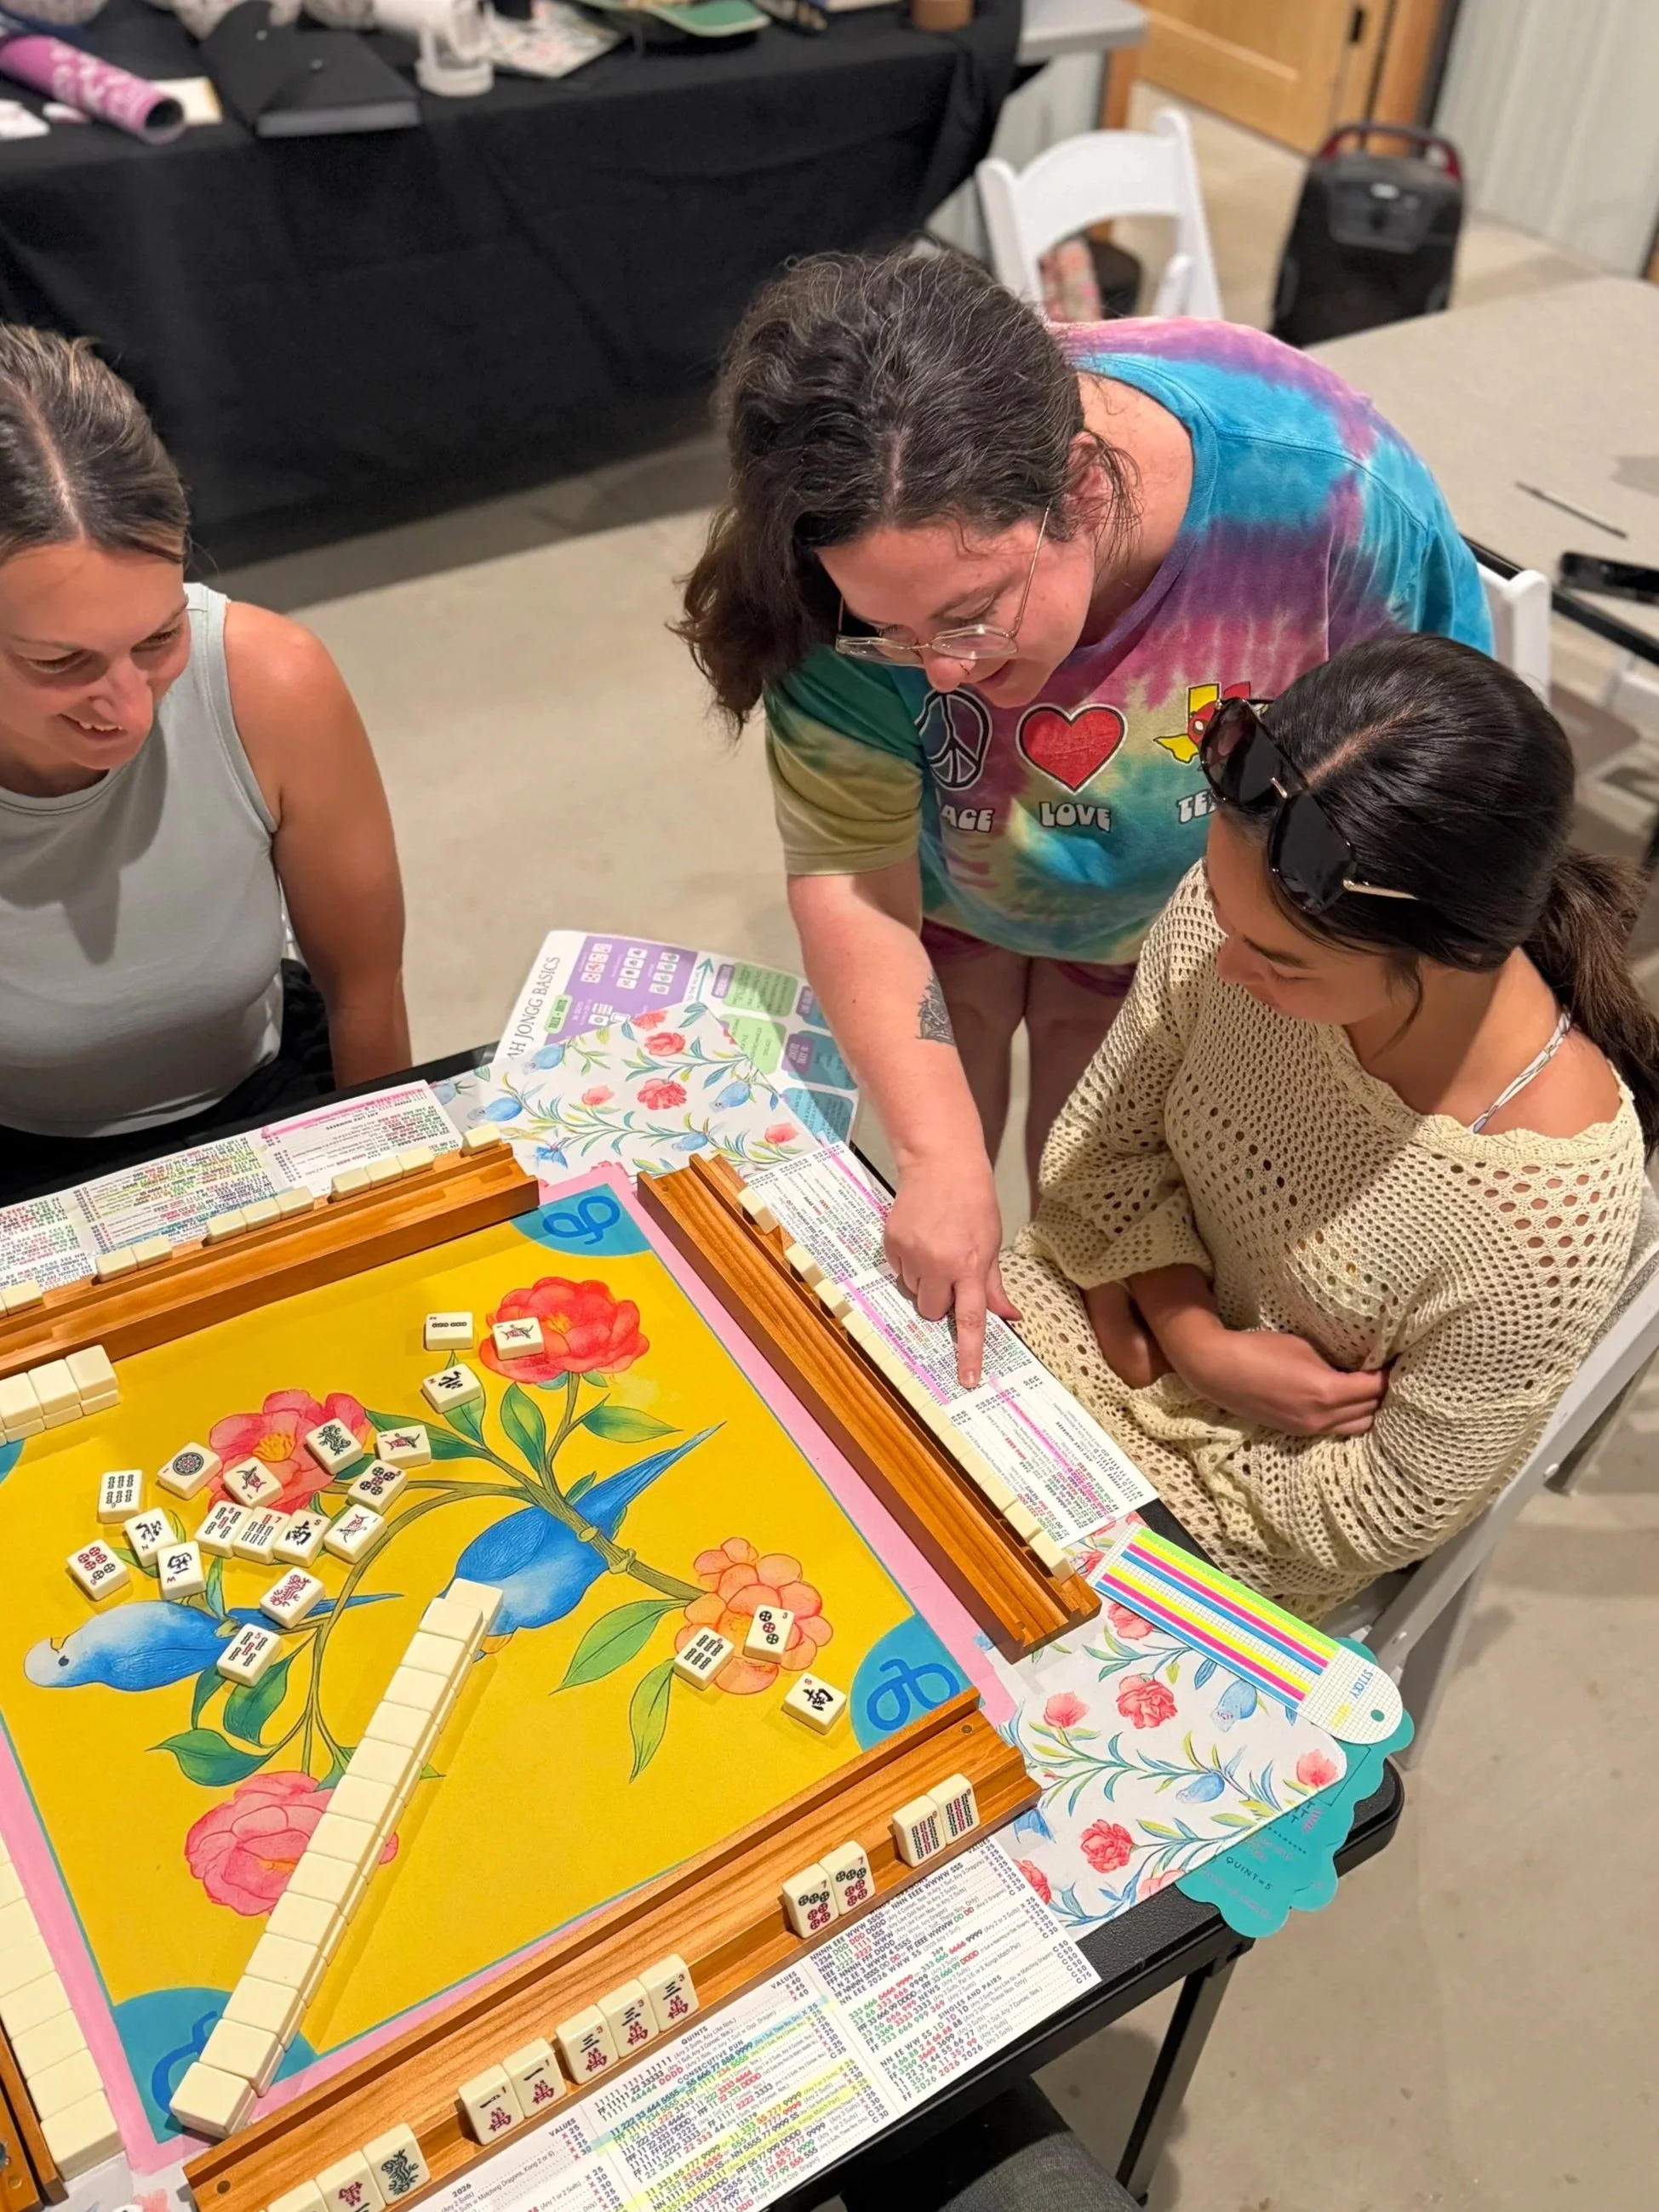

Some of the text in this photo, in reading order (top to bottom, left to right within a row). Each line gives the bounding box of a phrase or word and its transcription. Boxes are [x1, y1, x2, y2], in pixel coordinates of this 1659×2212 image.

[1039, 802, 1111, 833] LOVE
[507, 957, 560, 1060] AH JONGG BASICS
[285, 1520, 312, 1546] 南
[1350, 1668, 1374, 1700] STICKY
[809, 1944, 832, 1962] NNNN
[832, 1935, 845, 1946] EEE
[844, 1922, 867, 1938] WWW
[867, 1911, 884, 1924] SSSS
[890, 1896, 907, 1909] NNN
[907, 1886, 924, 1899] EEEE
[923, 1870, 950, 1889] WWWW
[949, 1861, 964, 1872] SSS
[985, 1843, 995, 1851] 25
[814, 1918, 887, 1967] 1234 DDD DDD DDDD
[826, 1938, 895, 1986] FFF NNNN FFF DDDD
[838, 1994, 852, 2005] NN
[852, 1985, 867, 1997] EEE
[867, 1970, 888, 1986] 2026
[888, 1955, 911, 1973] WWW
[911, 1948, 922, 1958] SS
[1015, 1883, 1026, 1891] 30
[930, 1946, 944, 1957] 369
[678, 1974, 685, 1982] 3
[769, 1969, 798, 1991] VALUES
[936, 1974, 1003, 2020] SINGLES AND PAIRS
[638, 1999, 644, 2008] 3
[593, 2088, 621, 2109] 11111
[645, 2055, 672, 2076] 11111
[790, 1975, 801, 1986] 40
[597, 2106, 607, 2116] FF
[606, 2091, 630, 2110] 11111
[629, 2083, 641, 2095] 22
[640, 2069, 665, 2089] 33333
[794, 1982, 805, 1992] 45
[602, 2101, 628, 2122] 11111
[629, 2083, 658, 2104] 44444
[657, 2065, 684, 2086] DDDD
[798, 1988, 809, 1998] 40
[680, 2024, 708, 2046] QUINTS
[609, 2126, 621, 2137] 11
[620, 2116, 636, 2130] 222
[635, 2110, 646, 2121] 33
[645, 2100, 661, 2114] 444
[660, 2088, 680, 2105] 5555
[685, 2078, 697, 2088] 55
[695, 2068, 712, 2082] 666
[710, 2062, 721, 2072] 77
[719, 2052, 735, 2066] 888
[734, 2040, 754, 2057] 9999
[807, 2002, 818, 2012] 25
[676, 2038, 744, 2085] CONSECUTIVE RUN
[893, 2028, 975, 2088] 11 22 33 44 55 66 77
[901, 2043, 983, 2101] FF 2026 2026 2026
[548, 2117, 577, 2138] VALUES
[568, 2123, 581, 2135] 25
[735, 2111, 758, 2129] 13579
[523, 2160, 539, 2174] Kong
[572, 2130, 584, 2141] 25
[451, 2182, 472, 2198] 2026
